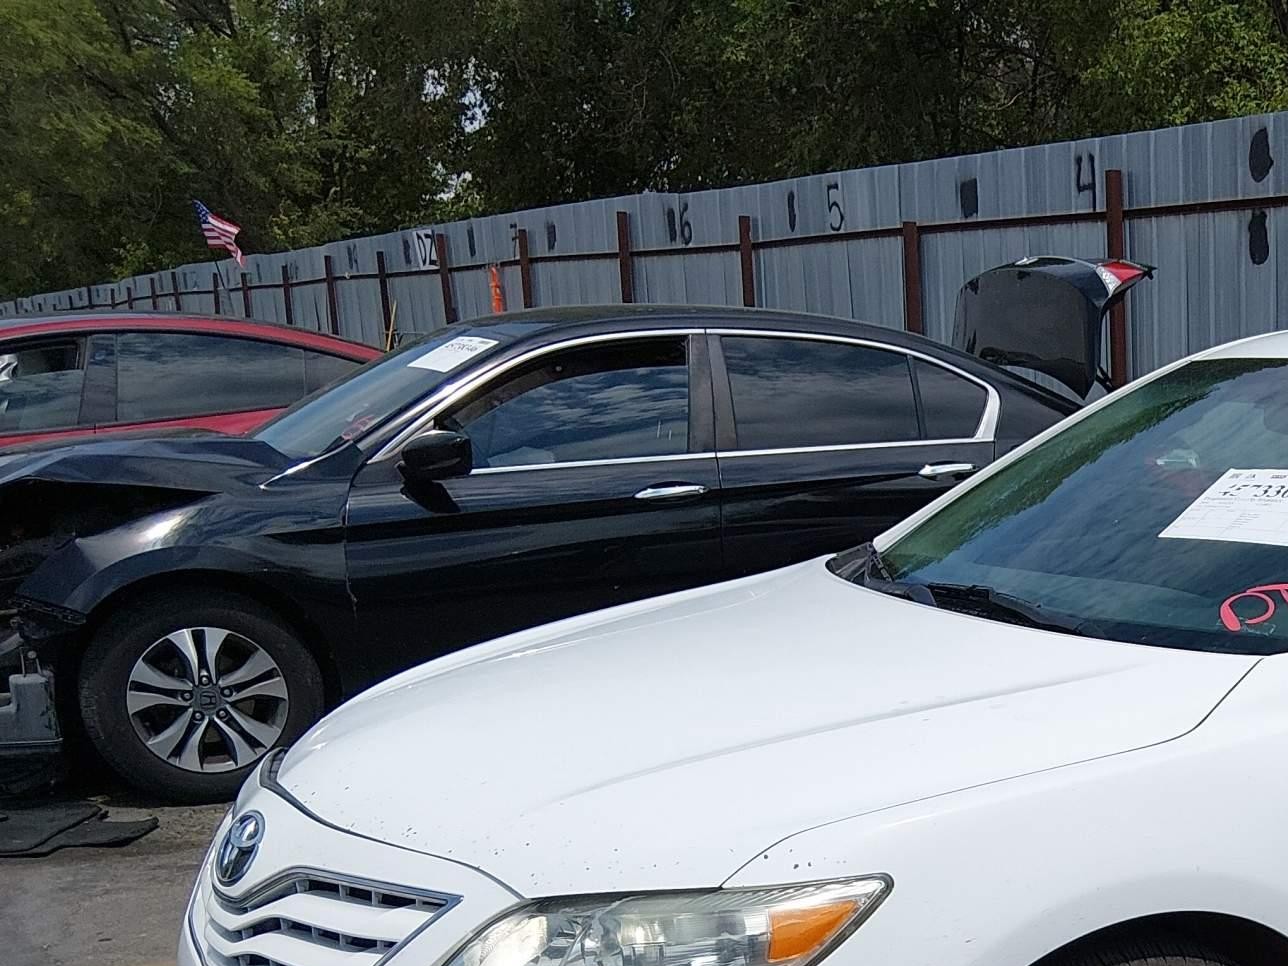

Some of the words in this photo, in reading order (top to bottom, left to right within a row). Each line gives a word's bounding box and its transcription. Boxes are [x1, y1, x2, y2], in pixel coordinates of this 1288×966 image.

[826, 182, 845, 232] 5
[1075, 152, 1097, 212] 4
[680, 202, 693, 246] 6
